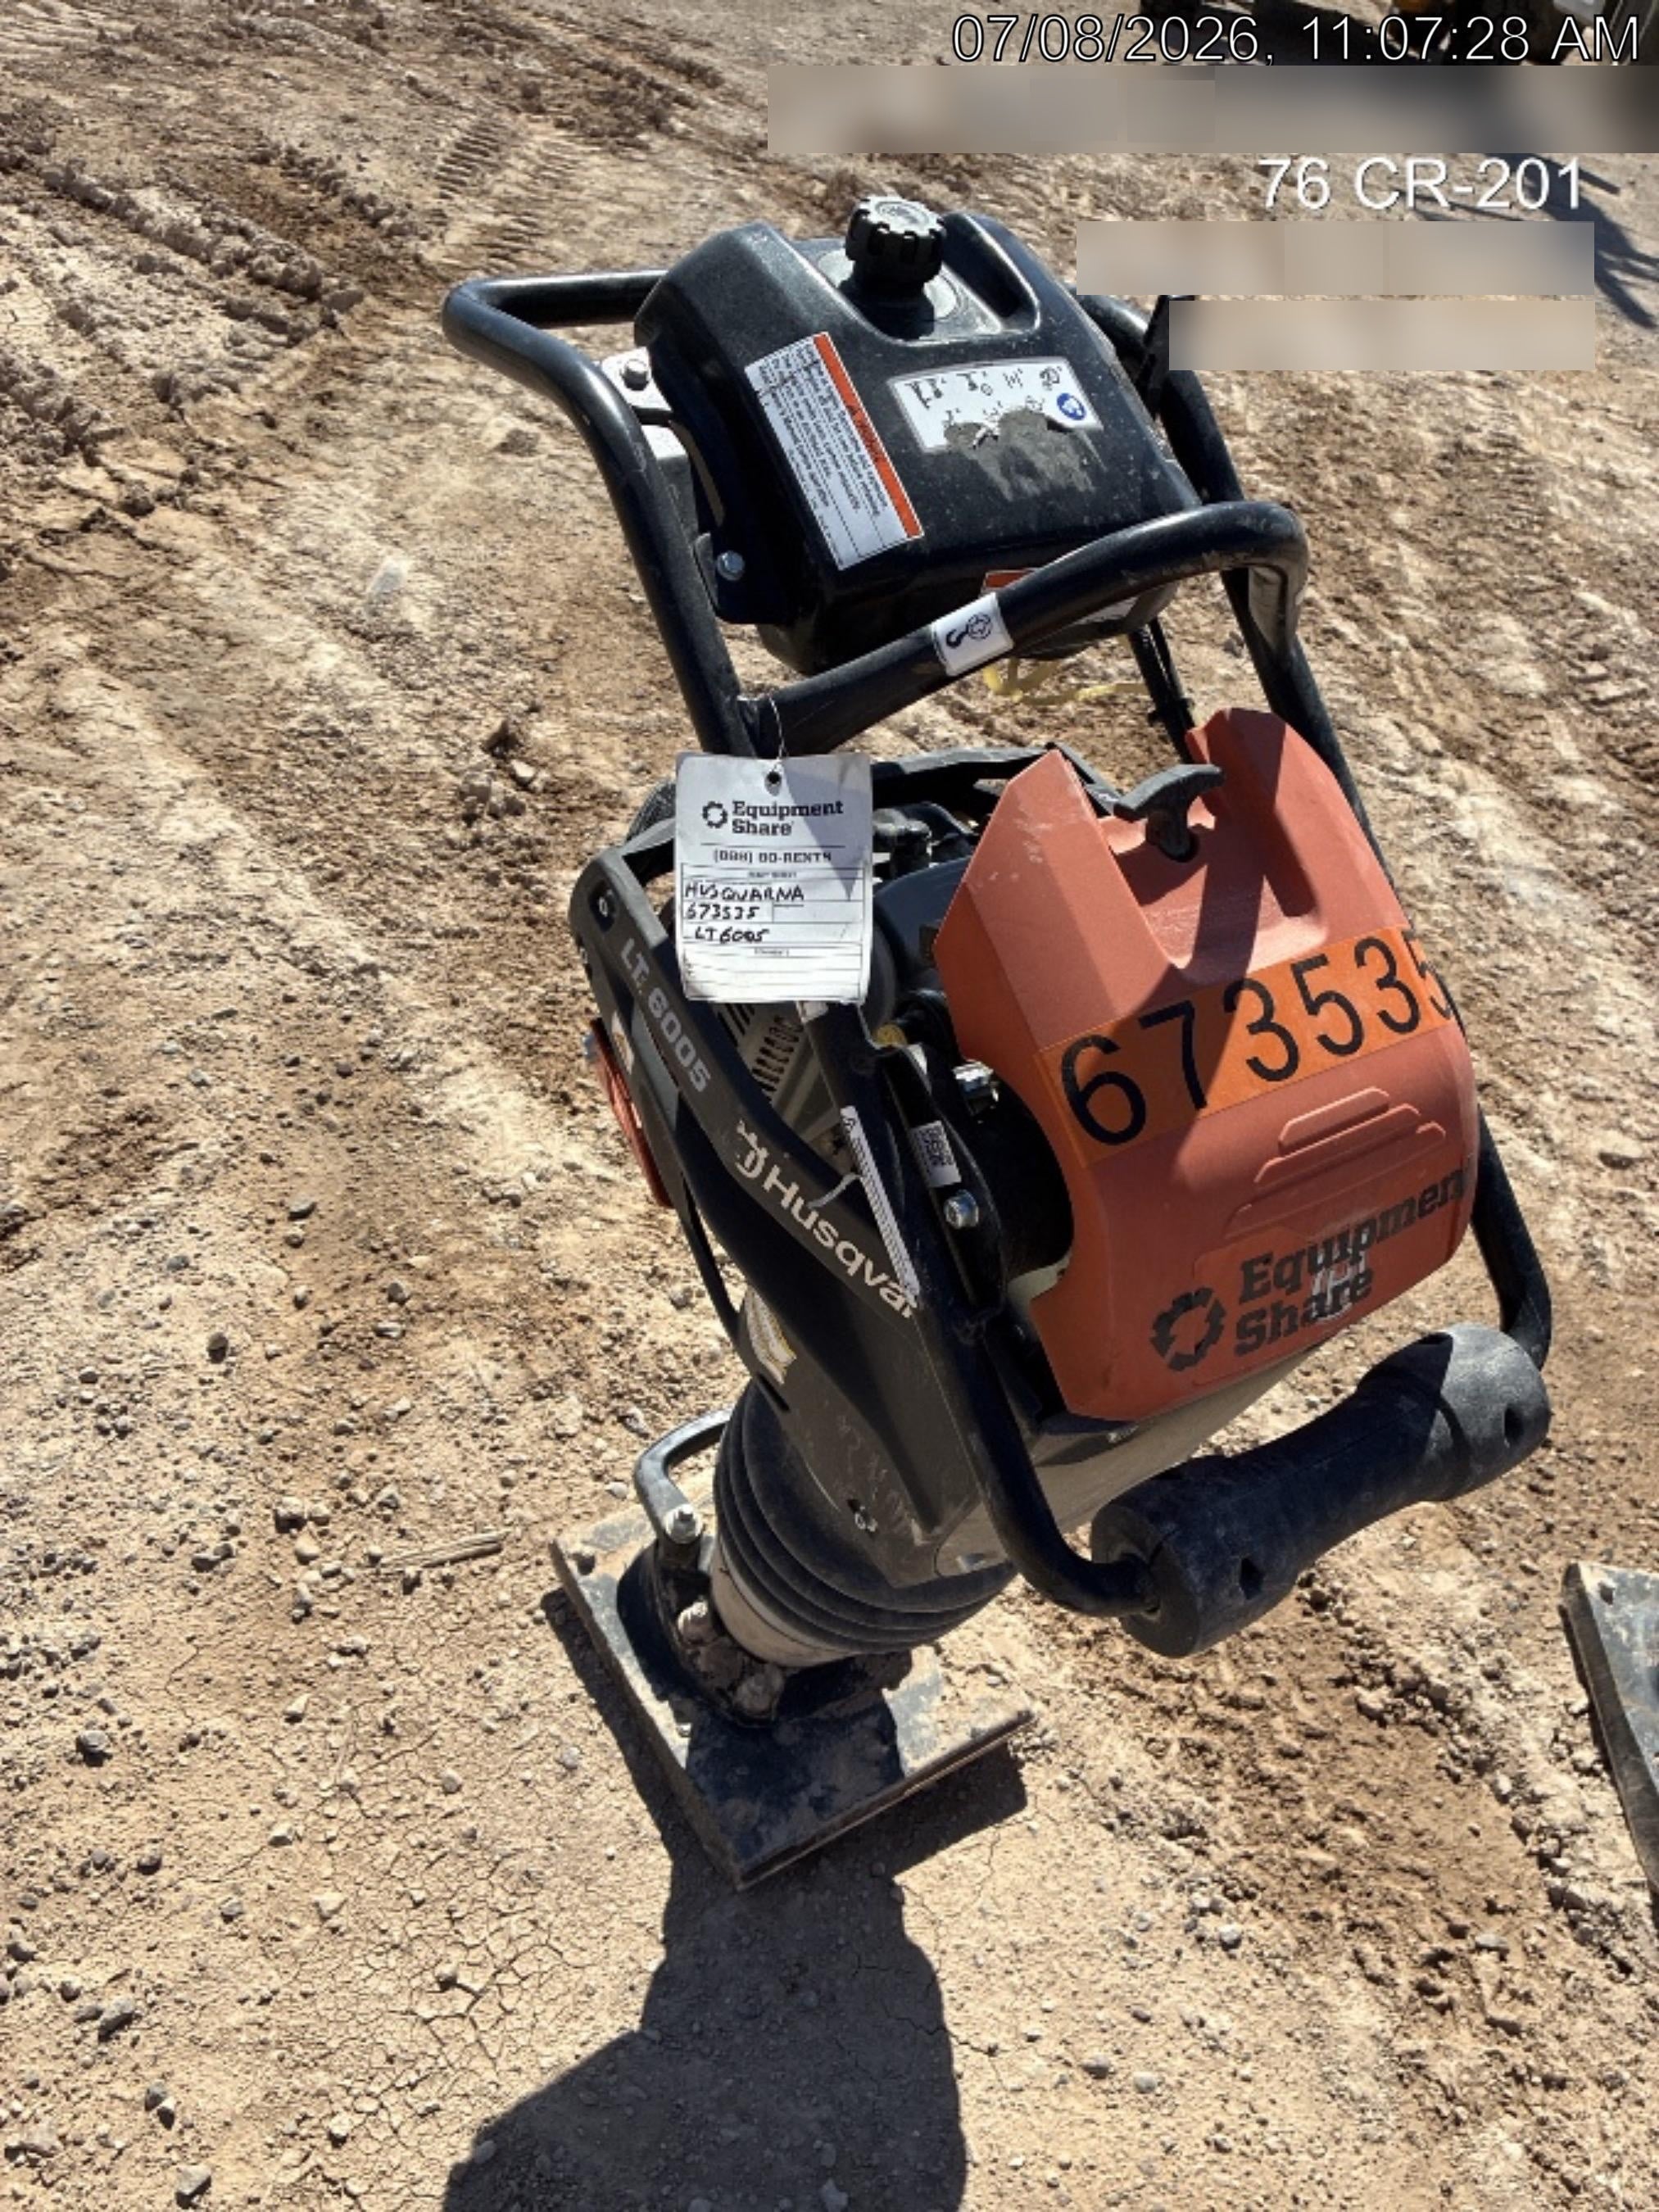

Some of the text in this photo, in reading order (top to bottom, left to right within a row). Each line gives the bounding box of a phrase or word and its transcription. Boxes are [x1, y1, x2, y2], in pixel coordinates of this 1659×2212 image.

[732, 800, 844, 820] Equipment
[732, 819, 793, 836] Share
[645, 987, 712, 1093] 6005
[1232, 1267, 1373, 1357] Share
